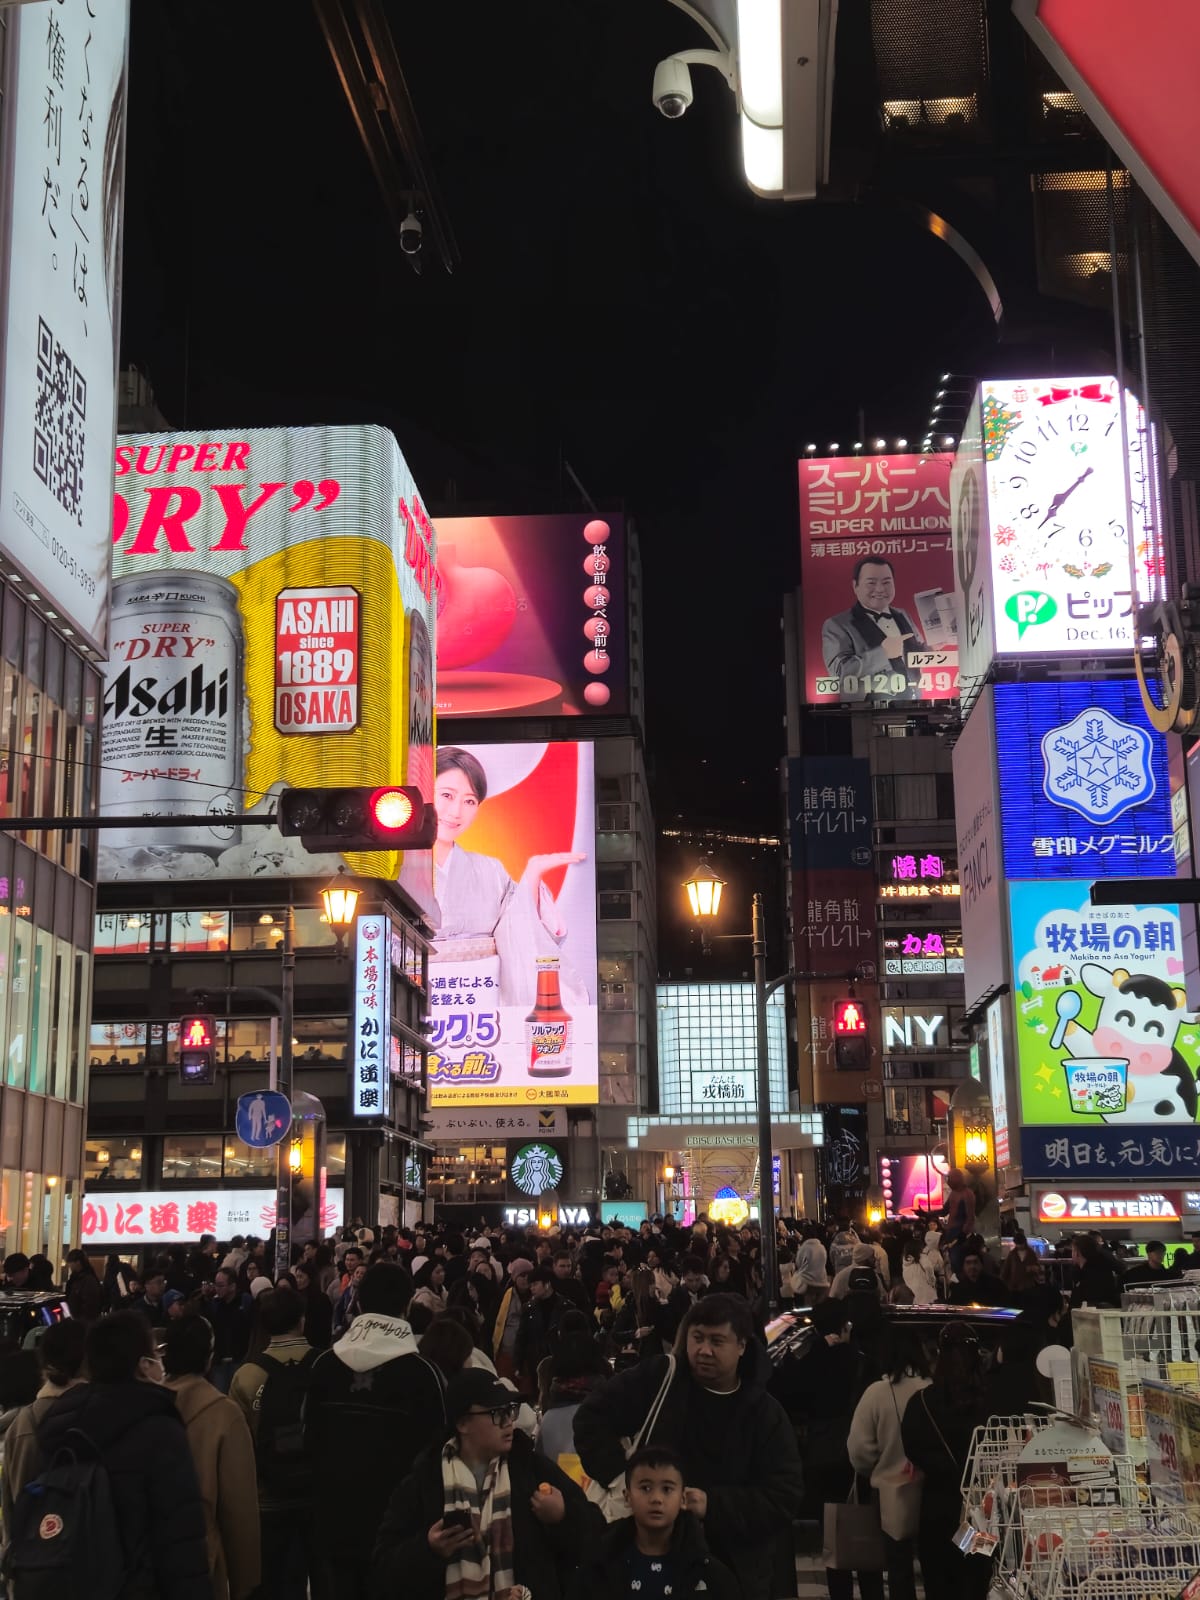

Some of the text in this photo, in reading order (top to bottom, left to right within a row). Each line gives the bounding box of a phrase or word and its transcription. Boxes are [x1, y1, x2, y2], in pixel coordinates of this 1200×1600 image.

[1037, 419, 1060, 441] 11
[1067, 413, 1089, 432] 12
[114, 441, 251, 476] SUPER
[1014, 440, 1038, 465] 10
[808, 460, 917, 490] スーパー
[1009, 475, 1029, 489] 9
[112, 479, 341, 556] RY”
[1020, 503, 1040, 520] 8
[809, 515, 953, 535] SUPER MILLION
[1048, 522, 1066, 539] 7
[1108, 518, 1126, 538] 5
[1078, 527, 1094, 548] 6
[180, 593, 206, 601] KUCHI
[593, 544, 608, 660] 飲む前・食べる前に
[141, 622, 191, 634] SUPER
[279, 599, 354, 635] ASAHI
[114, 636, 215, 661] “DRY”
[299, 636, 334, 649] since
[279, 649, 354, 684] 1889
[911, 653, 948, 666] ルアン
[103, 663, 228, 721] Asahi
[279, 688, 353, 726] OSAKA
[145, 725, 178, 748] 生
[121, 767, 201, 783] スーパードライ
[803, 786, 856, 809] 龍角散
[1032, 834, 1174, 857] 雪印メグミルク
[892, 854, 944, 879] 焼肉
[807, 898, 861, 923] 龍角散
[1045, 920, 1176, 953] 牧場の朝
[1069, 952, 1100, 961] Makiba
[1113, 952, 1129, 960] Asa
[1129, 952, 1156, 962] Yogurt
[362, 945, 379, 1009] 本場の味
[531, 1025, 565, 1035] ソルマック
[885, 1015, 945, 1047] NY
[1074, 1071, 1119, 1083] 牧場の朝
[1070, 1197, 1177, 1217] ZETTERIA
